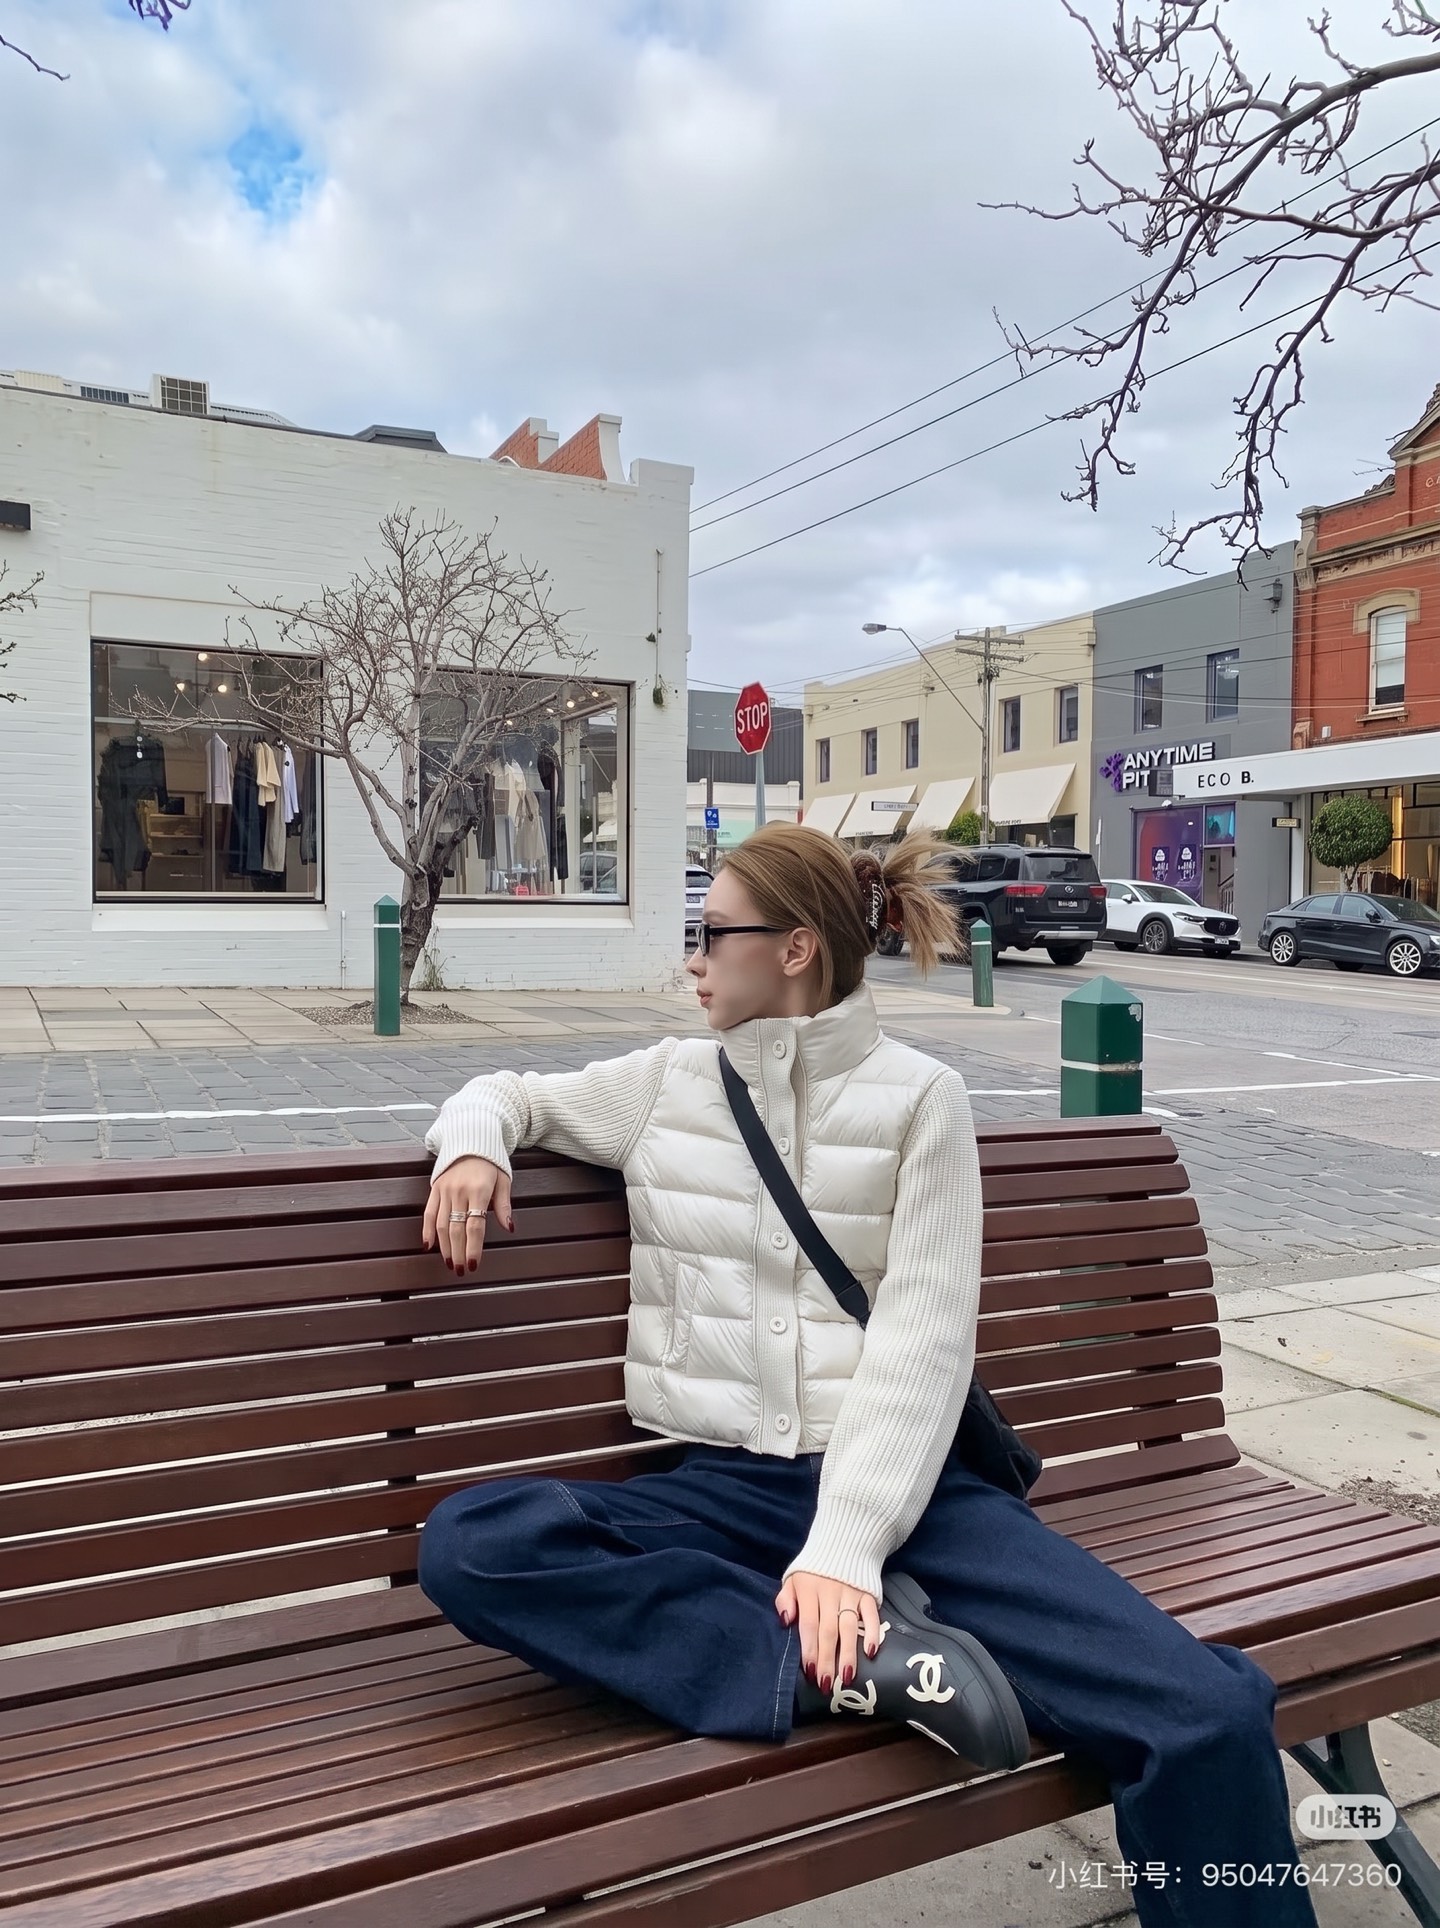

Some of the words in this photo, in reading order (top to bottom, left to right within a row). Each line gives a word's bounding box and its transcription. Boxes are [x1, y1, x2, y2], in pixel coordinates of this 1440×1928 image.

[737, 701, 768, 734] STOP
[1123, 741, 1214, 770] ANYTIME
[1198, 772, 1231, 788] ECO
